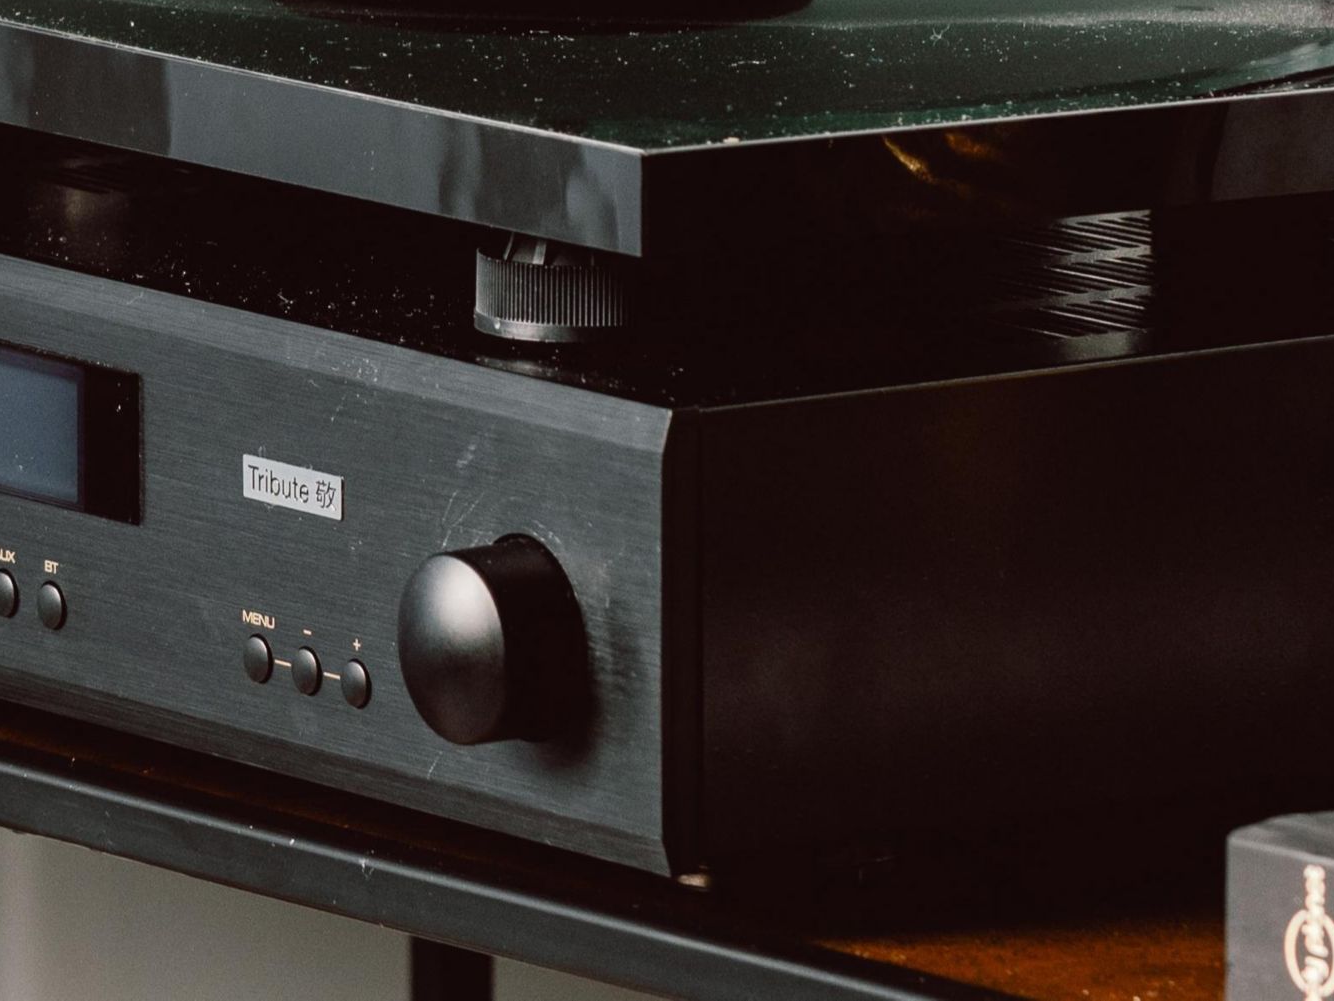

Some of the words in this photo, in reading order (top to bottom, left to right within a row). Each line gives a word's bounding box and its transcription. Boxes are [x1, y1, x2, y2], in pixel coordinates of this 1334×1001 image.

[247, 464, 310, 504] Tribute
[315, 479, 337, 511] 敬
[44, 559, 59, 575] BT
[242, 609, 275, 629] MENU
